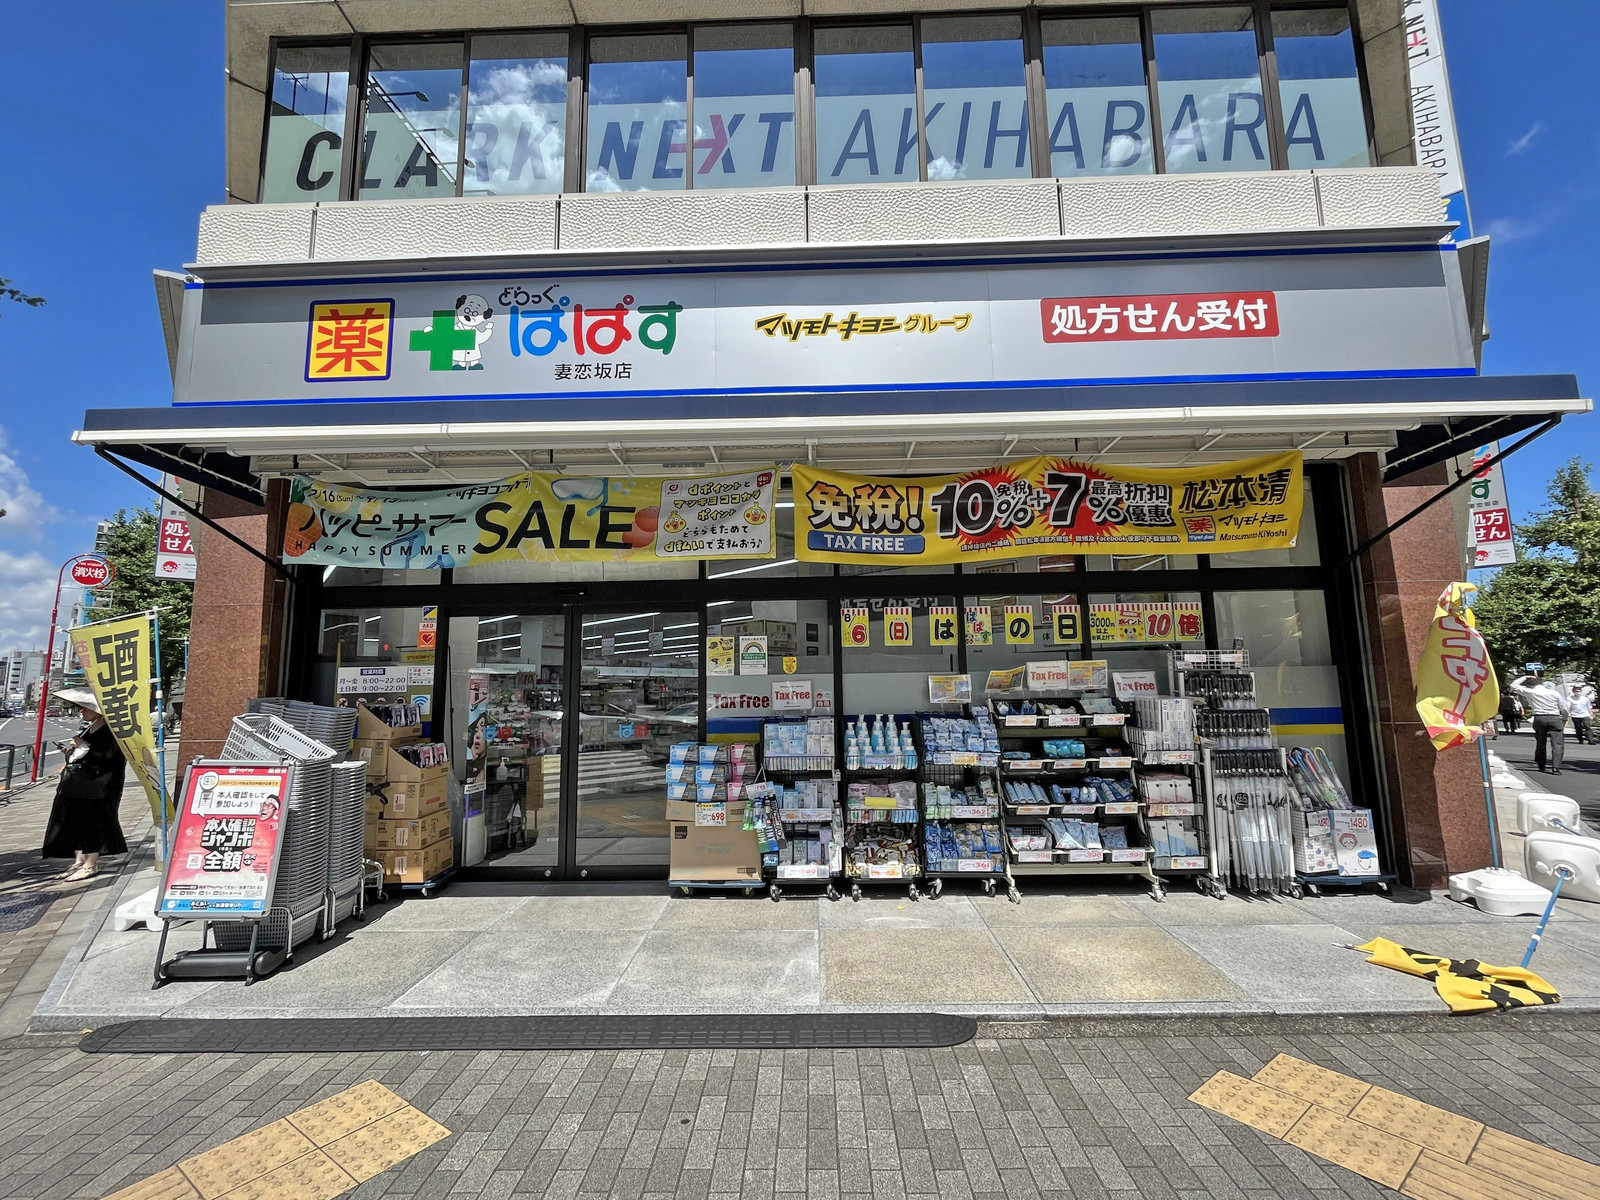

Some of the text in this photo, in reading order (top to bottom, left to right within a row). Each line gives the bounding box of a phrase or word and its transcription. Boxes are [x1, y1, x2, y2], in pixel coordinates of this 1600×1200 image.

[296, 92, 1326, 191] CLARK NEXT AKIHABARA
[498, 284, 561, 307] どらっぐ
[509, 294, 684, 357] ぱぱす
[1050, 299, 1269, 336] 処方せん受付
[316, 308, 386, 373] 薬
[554, 362, 633, 380] 妻恋坂店
[1091, 480, 1122, 496] 最高
[1124, 482, 1172, 504] 折扣
[1178, 468, 1293, 514] 松本清
[697, 508, 737, 521] ポイント
[1218, 511, 1288, 529] マツモトキヨシ
[299, 508, 467, 539] ハッピーサマー
[472, 499, 637, 555] SALE
[683, 524, 748, 538] どちらもためて
[295, 541, 467, 557] HAPPY SUMMER
[824, 534, 904, 551] TAX FREE
[74, 566, 105, 579] 消火栓
[934, 618, 955, 640] は
[1010, 617, 1031, 639] の
[1058, 614, 1078, 640] 日
[1031, 671, 1067, 681] Tax Free
[1117, 682, 1155, 691] Tax Free
[713, 693, 770, 709] Tax Free
[775, 691, 810, 700] Tax Free
[217, 791, 266, 799] 本人確認をして
[204, 818, 255, 831] 本人確認
[201, 831, 253, 846] ジャンボ
[203, 850, 242, 870] 全額
